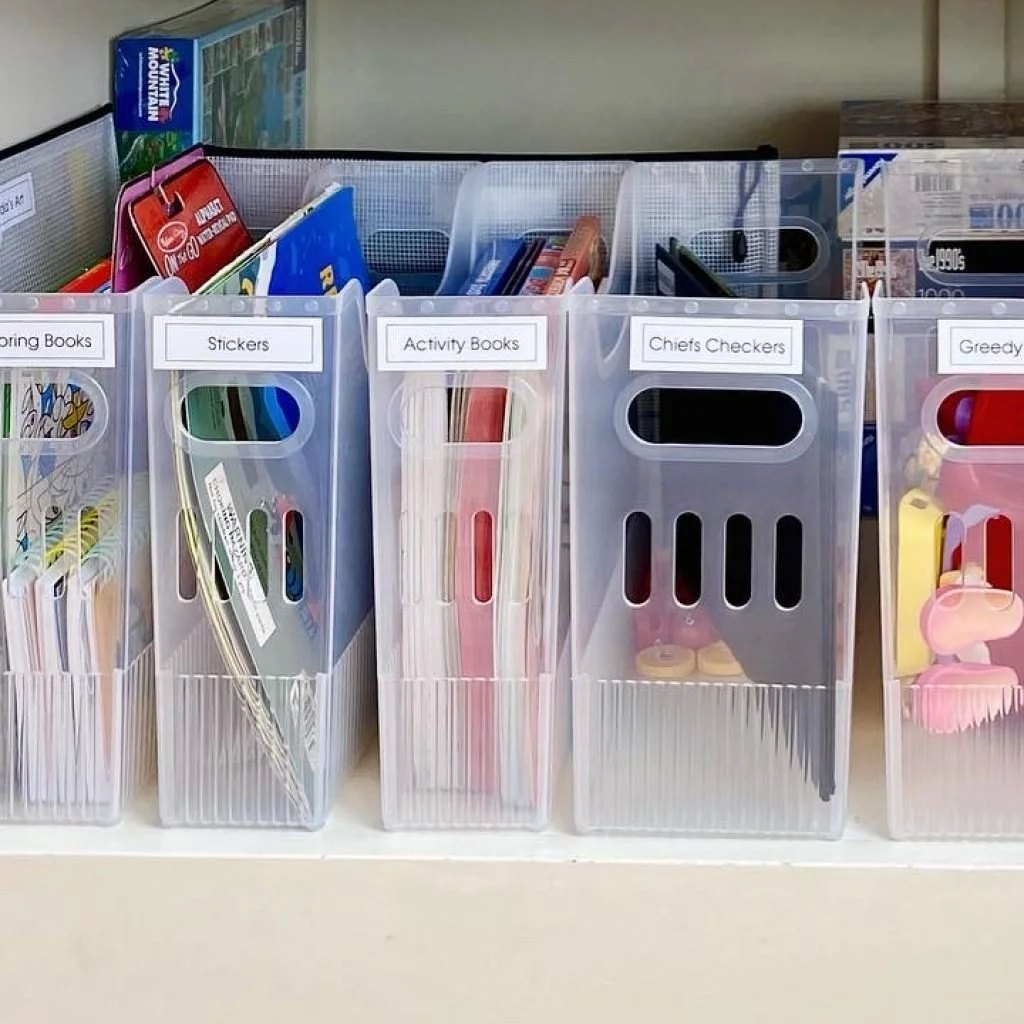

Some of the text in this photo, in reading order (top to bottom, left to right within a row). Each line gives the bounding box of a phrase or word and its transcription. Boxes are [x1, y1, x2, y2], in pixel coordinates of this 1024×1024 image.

[147, 46, 159, 122] MOUNTAIN
[159, 62, 170, 107] WHITE
[45, 333, 92, 349] Books
[207, 336, 270, 352] Stickers
[403, 336, 520, 354] Activity Books
[649, 336, 786, 354] Chiefs Checkers
[959, 339, 1023, 357] Greedy
